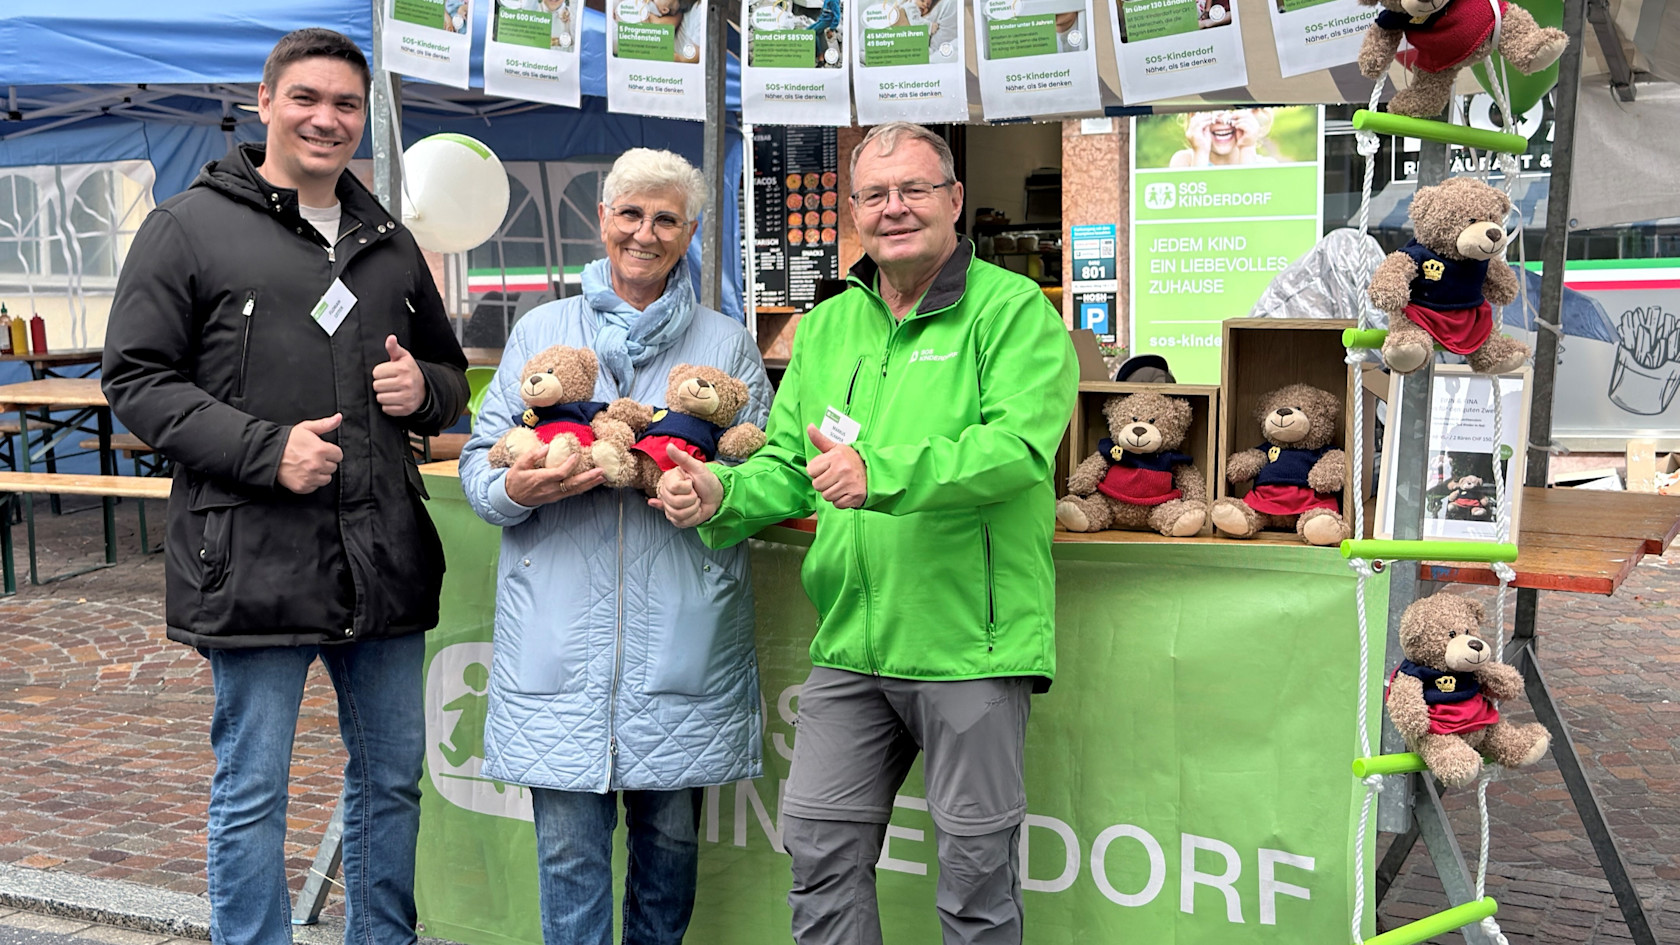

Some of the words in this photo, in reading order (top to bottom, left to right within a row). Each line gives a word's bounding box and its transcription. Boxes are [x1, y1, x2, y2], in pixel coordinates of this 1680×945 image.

[500, 10, 516, 19] Über
[530, 15, 550, 24] Kinder
[1305, 9, 1379, 33] SOS-Kinderdorf
[620, 34, 660, 42] Liechtenstein
[624, 26, 662, 36] Programme
[1305, 33, 1329, 43] Näher,
[1355, 23, 1372, 32] denk
[1145, 46, 1214, 64] SOS-Kinderdorf
[506, 59, 558, 72] SOS-Kinderdorf
[1145, 65, 1168, 74] Näher,
[1191, 56, 1216, 66] denken
[629, 74, 683, 84] SOS-Kinderdorf
[1006, 69, 1070, 82] SOS-Kinderdorf
[880, 80, 940, 90] SOS-Kinderdorf
[1540, 153, 1552, 168] &
[1179, 182, 1207, 195] SOS
[1179, 192, 1272, 207] KINDERDORF
[1150, 238, 1203, 252] JEDEM
[1208, 236, 1246, 251] KIND
[1150, 259, 1176, 273] EIN
[1181, 256, 1288, 272] LIEBEVOLLES
[1082, 266, 1105, 279] 801
[1149, 279, 1224, 294] ZUHAUSE
[1087, 308, 1104, 330] P
[1150, 334, 1222, 347] sos-kinde
[705, 779, 1315, 925] INEDORF
